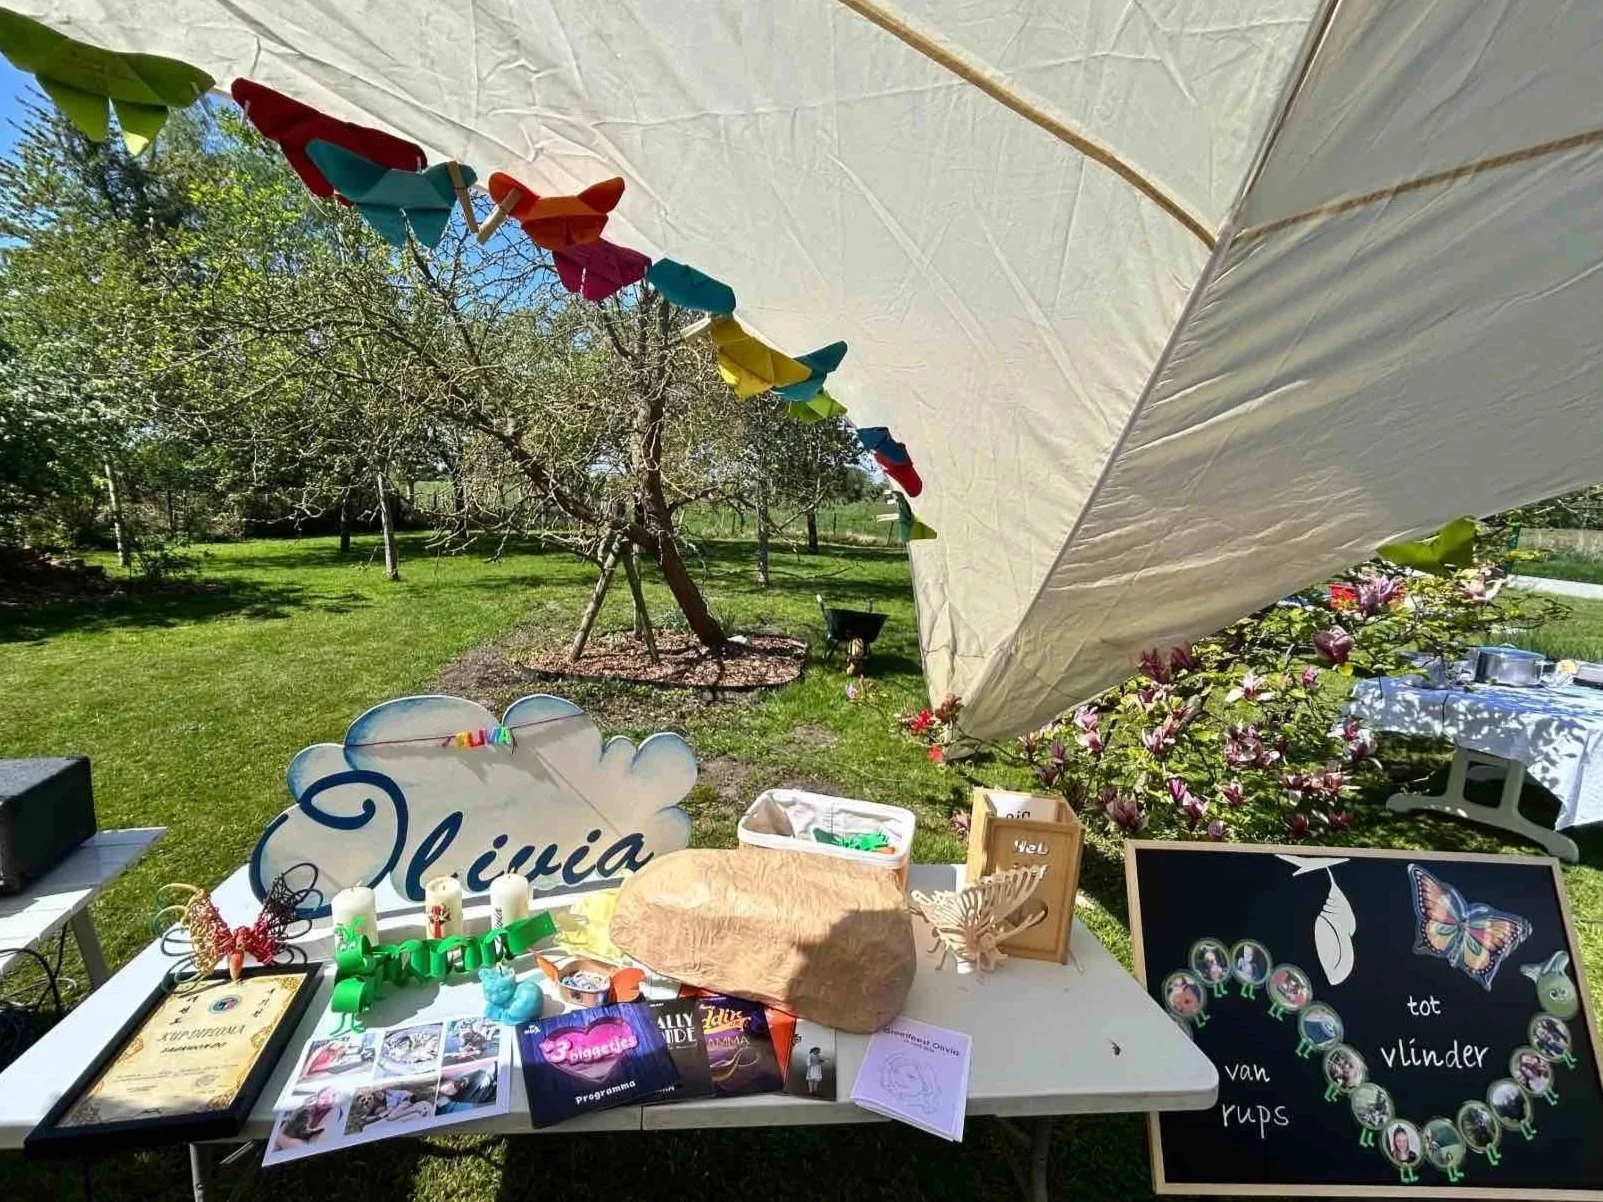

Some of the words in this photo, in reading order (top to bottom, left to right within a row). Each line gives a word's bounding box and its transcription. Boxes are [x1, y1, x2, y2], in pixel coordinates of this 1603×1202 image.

[248, 769, 655, 920] Olivia
[1406, 995, 1442, 1016] tot
[656, 1011, 694, 1029] ALLY
[1380, 1038, 1489, 1070] vlinder
[1225, 1061, 1271, 1083] van
[575, 1080, 636, 1105] Programma
[1221, 1103, 1290, 1140] rups
